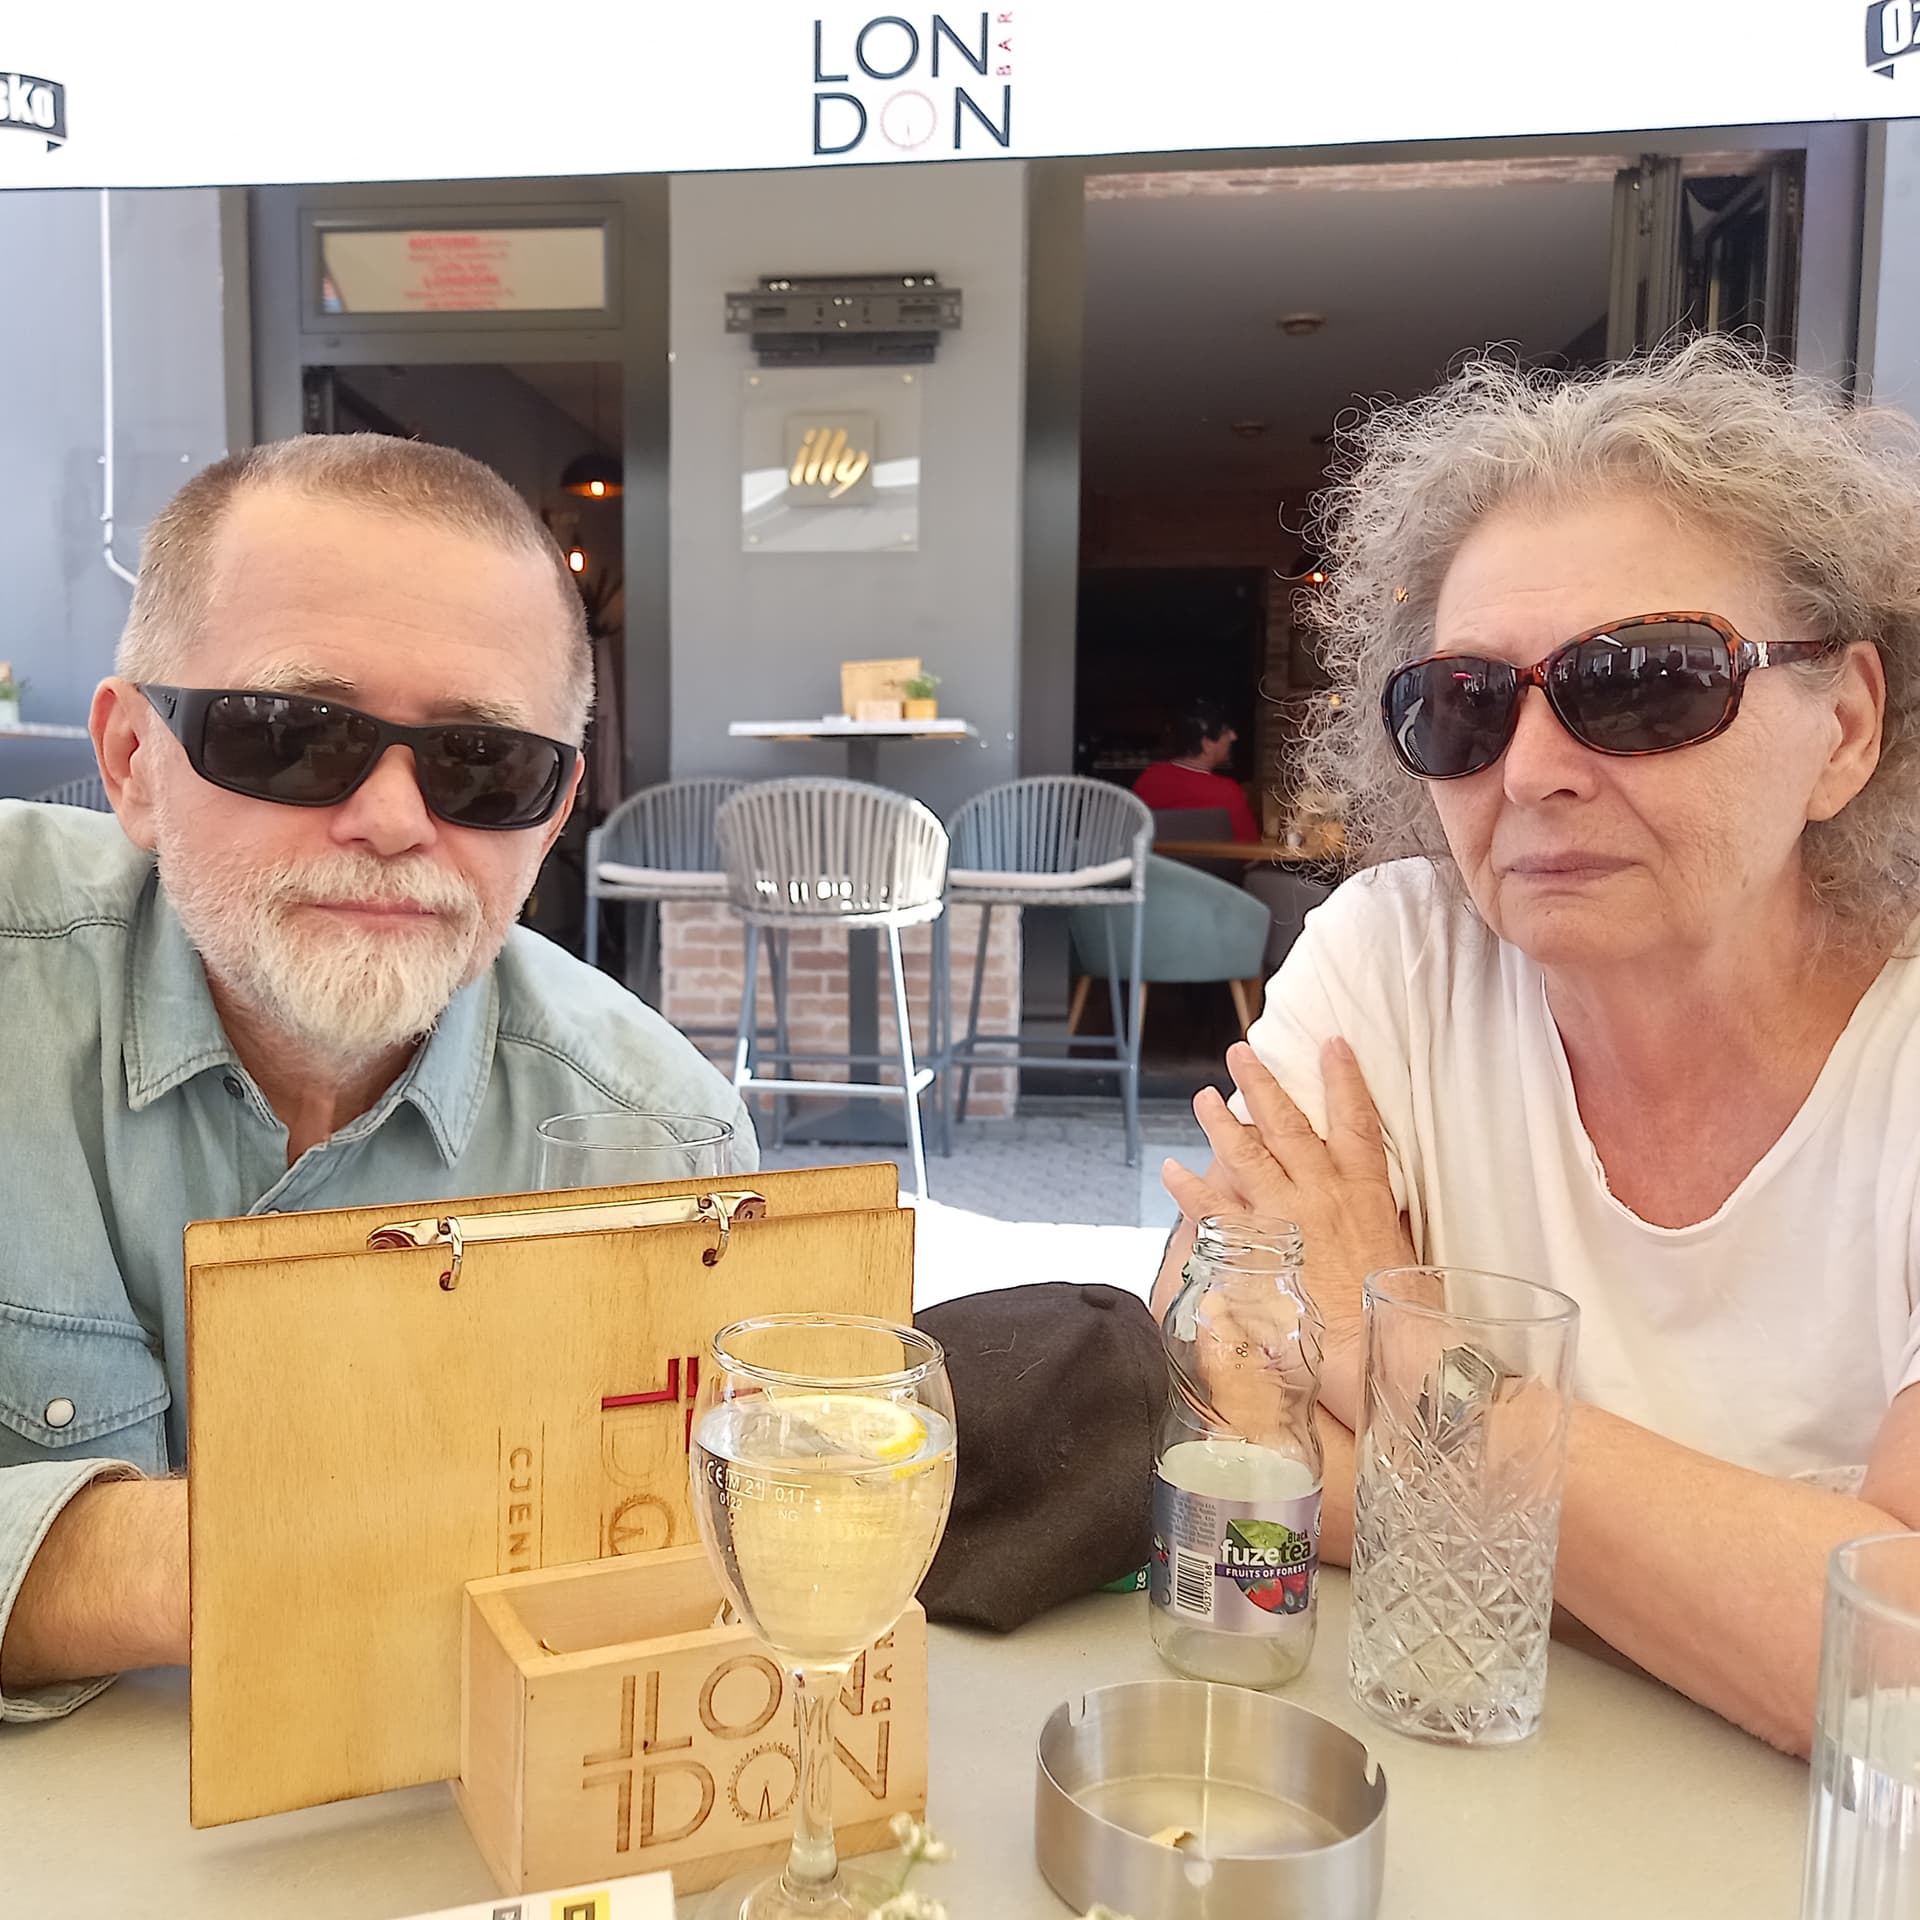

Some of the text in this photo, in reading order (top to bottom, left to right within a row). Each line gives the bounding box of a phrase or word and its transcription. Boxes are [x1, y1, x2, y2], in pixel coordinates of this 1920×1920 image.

[814, 12, 988, 82] LON
[996, 10, 1013, 77] BAR
[813, 84, 1011, 155] DON
[789, 427, 869, 498] illy
[1226, 1562, 1306, 1578] FRUITS OF FOREST
[1287, 1529, 1309, 1543] Black
